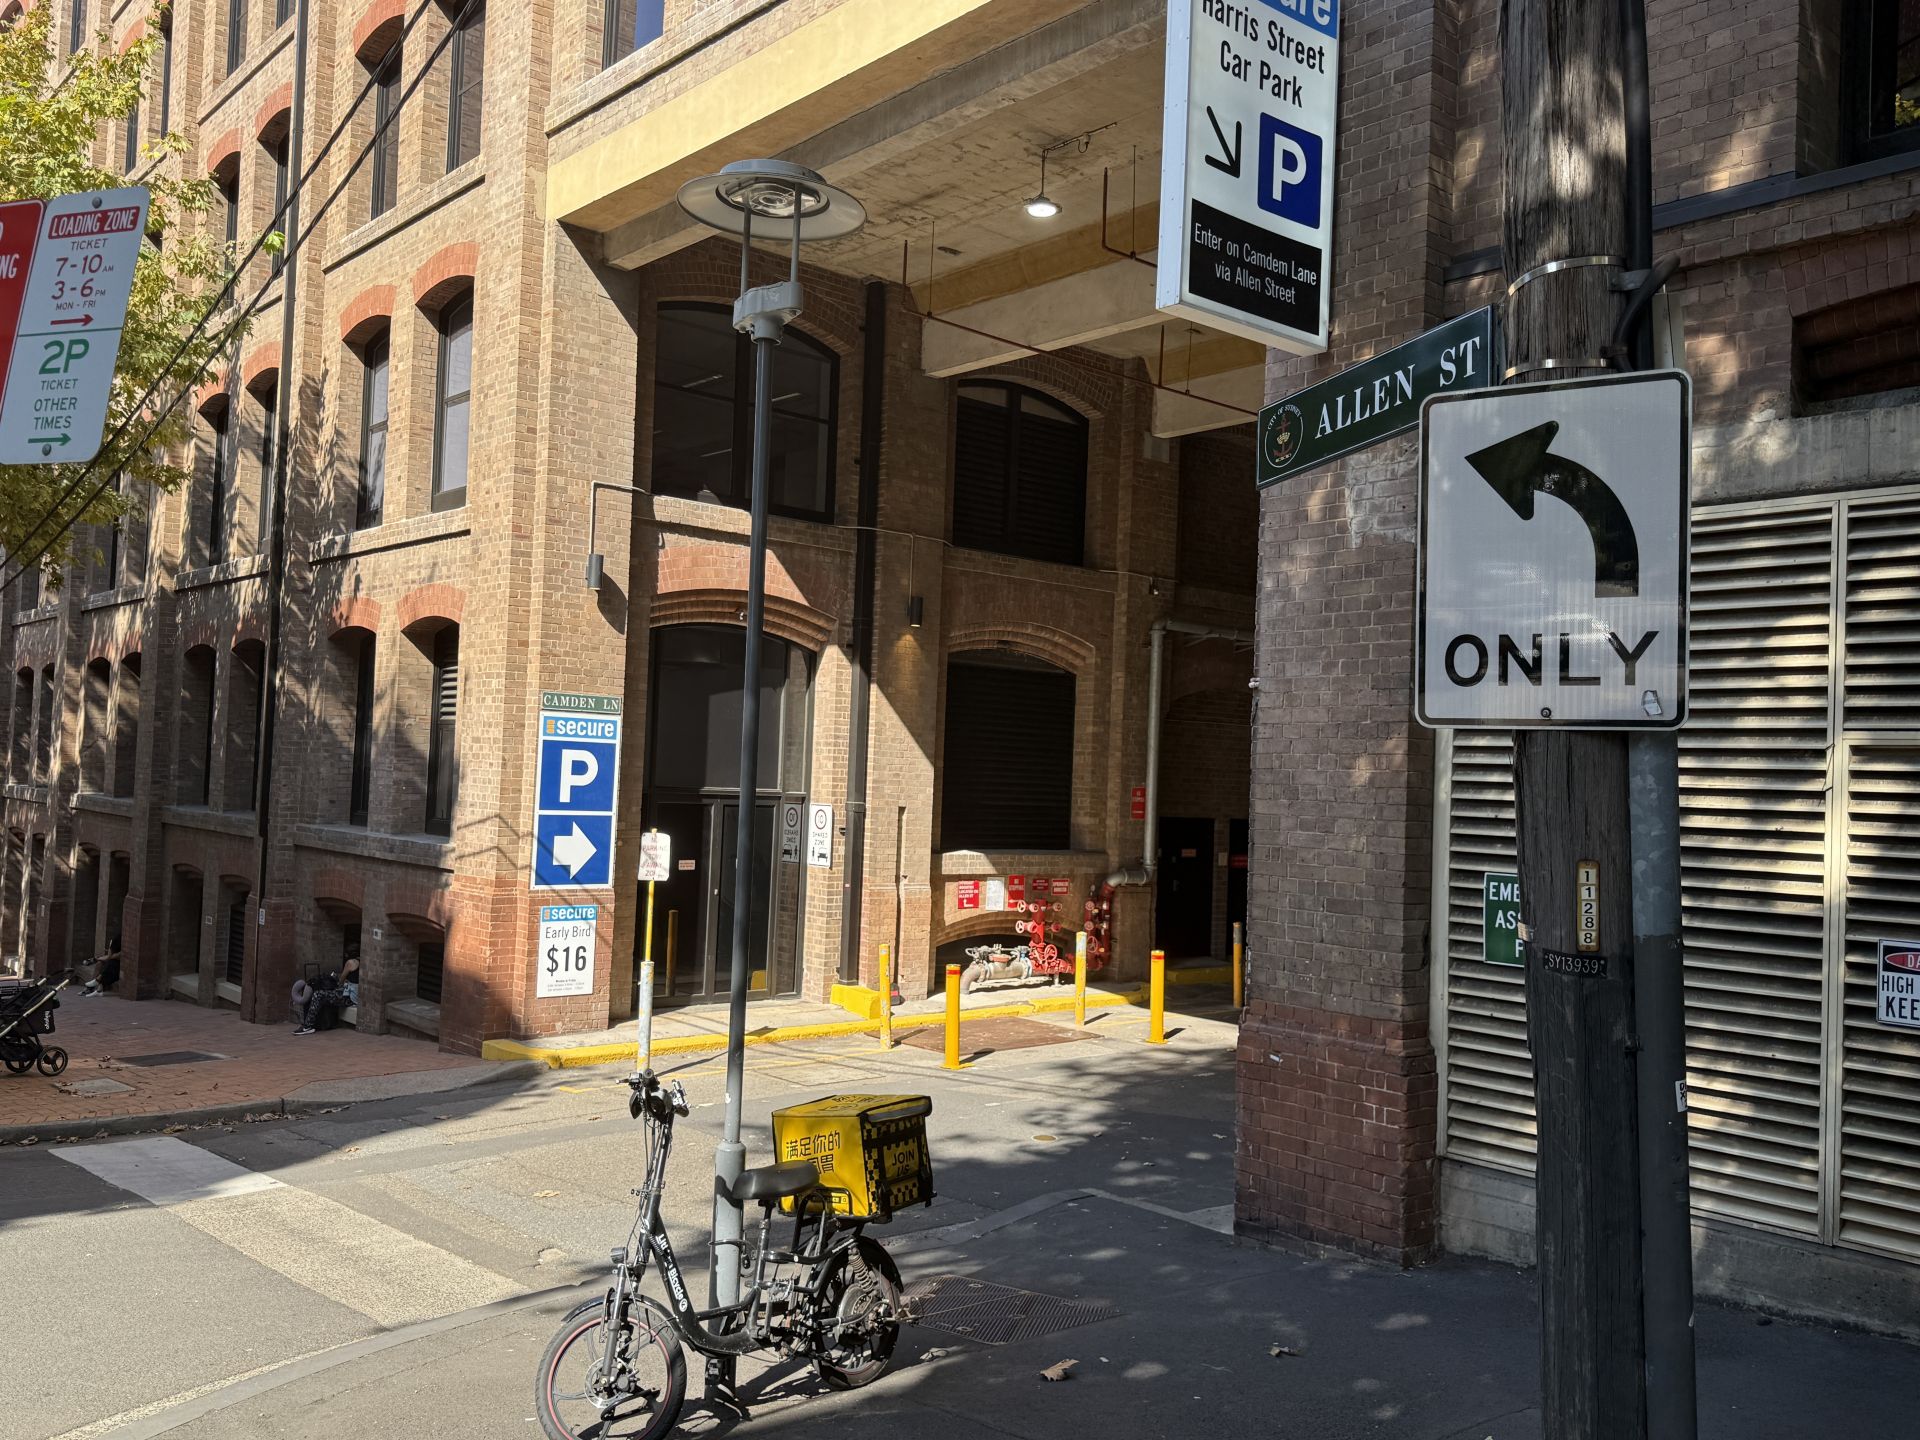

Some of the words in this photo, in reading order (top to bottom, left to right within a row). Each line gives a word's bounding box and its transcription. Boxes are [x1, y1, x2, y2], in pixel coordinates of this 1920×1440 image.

[1267, 20, 1325, 75] Street
[1220, 40, 1252, 82] Car
[1259, 60, 1303, 109] Park
[1272, 132, 1307, 202] P
[51, 214, 101, 236] LOADING
[104, 209, 136, 231] ZONE
[70, 238, 108, 251] TICKET
[1194, 222, 1223, 251] Enter
[1226, 241, 1240, 259] on
[1243, 243, 1288, 277] Camdem
[1291, 260, 1317, 286] Lane
[1215, 260, 1231, 282] via
[1235, 266, 1261, 293] Allen
[1265, 277, 1296, 305] Street
[56, 302, 74, 311] MON
[83, 300, 96, 309] FRI
[38, 338, 90, 375] 2P
[40, 378, 78, 391] TICKET
[1314, 363, 1416, 439] ALLEN
[1439, 336, 1481, 387] ST
[34, 397, 78, 412] OTHER
[33, 415, 72, 431] TIMES
[1444, 630, 1660, 688] ONLY
[543, 694, 596, 709] CAMDEN
[603, 699, 619, 710] LN
[556, 719, 614, 737] secure
[559, 748, 599, 803] P
[551, 907, 595, 920] secure
[545, 926, 570, 940] Early
[572, 925, 591, 938] Bird
[546, 944, 587, 976] $16
[1548, 953, 1599, 974] SY13939
[1881, 974, 1914, 995] HIGH
[786, 1130, 841, 1160] 满足你的
[892, 1149, 915, 1166] JOIN
